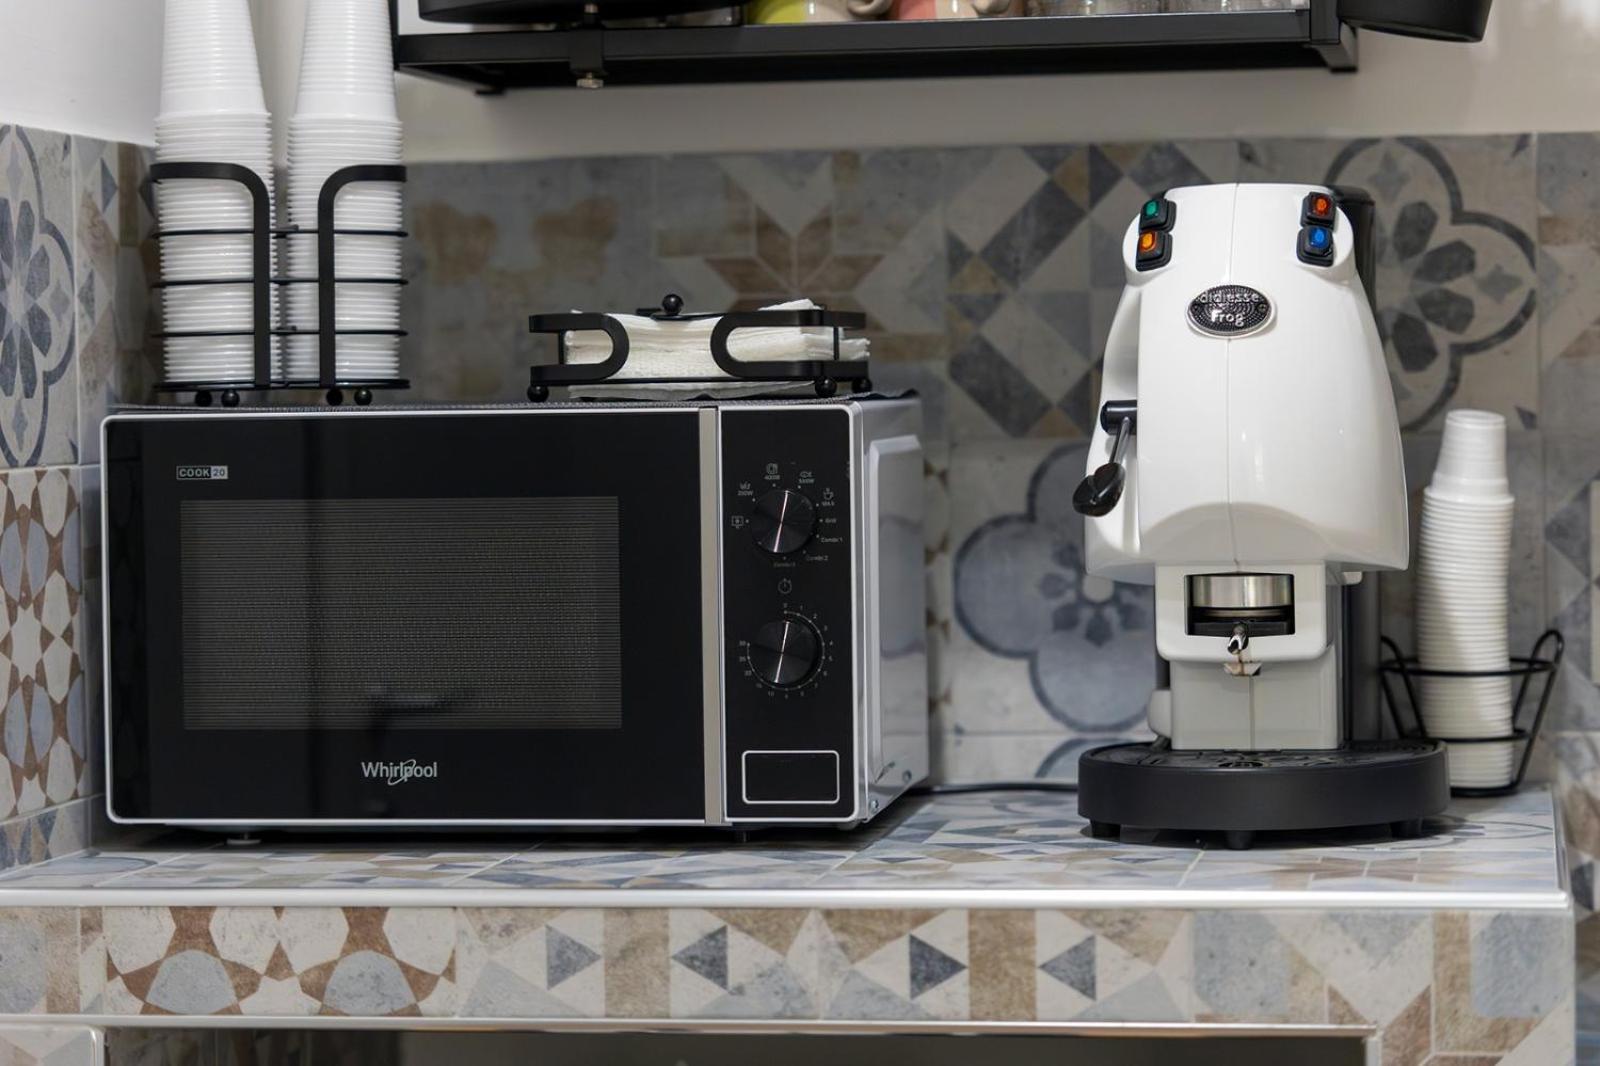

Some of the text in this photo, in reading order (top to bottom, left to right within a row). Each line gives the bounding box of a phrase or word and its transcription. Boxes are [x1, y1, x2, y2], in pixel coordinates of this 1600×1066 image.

[1211, 309, 1245, 328] Frog
[179, 467, 226, 478] COOK 20
[361, 760, 438, 786] Whirlpool
